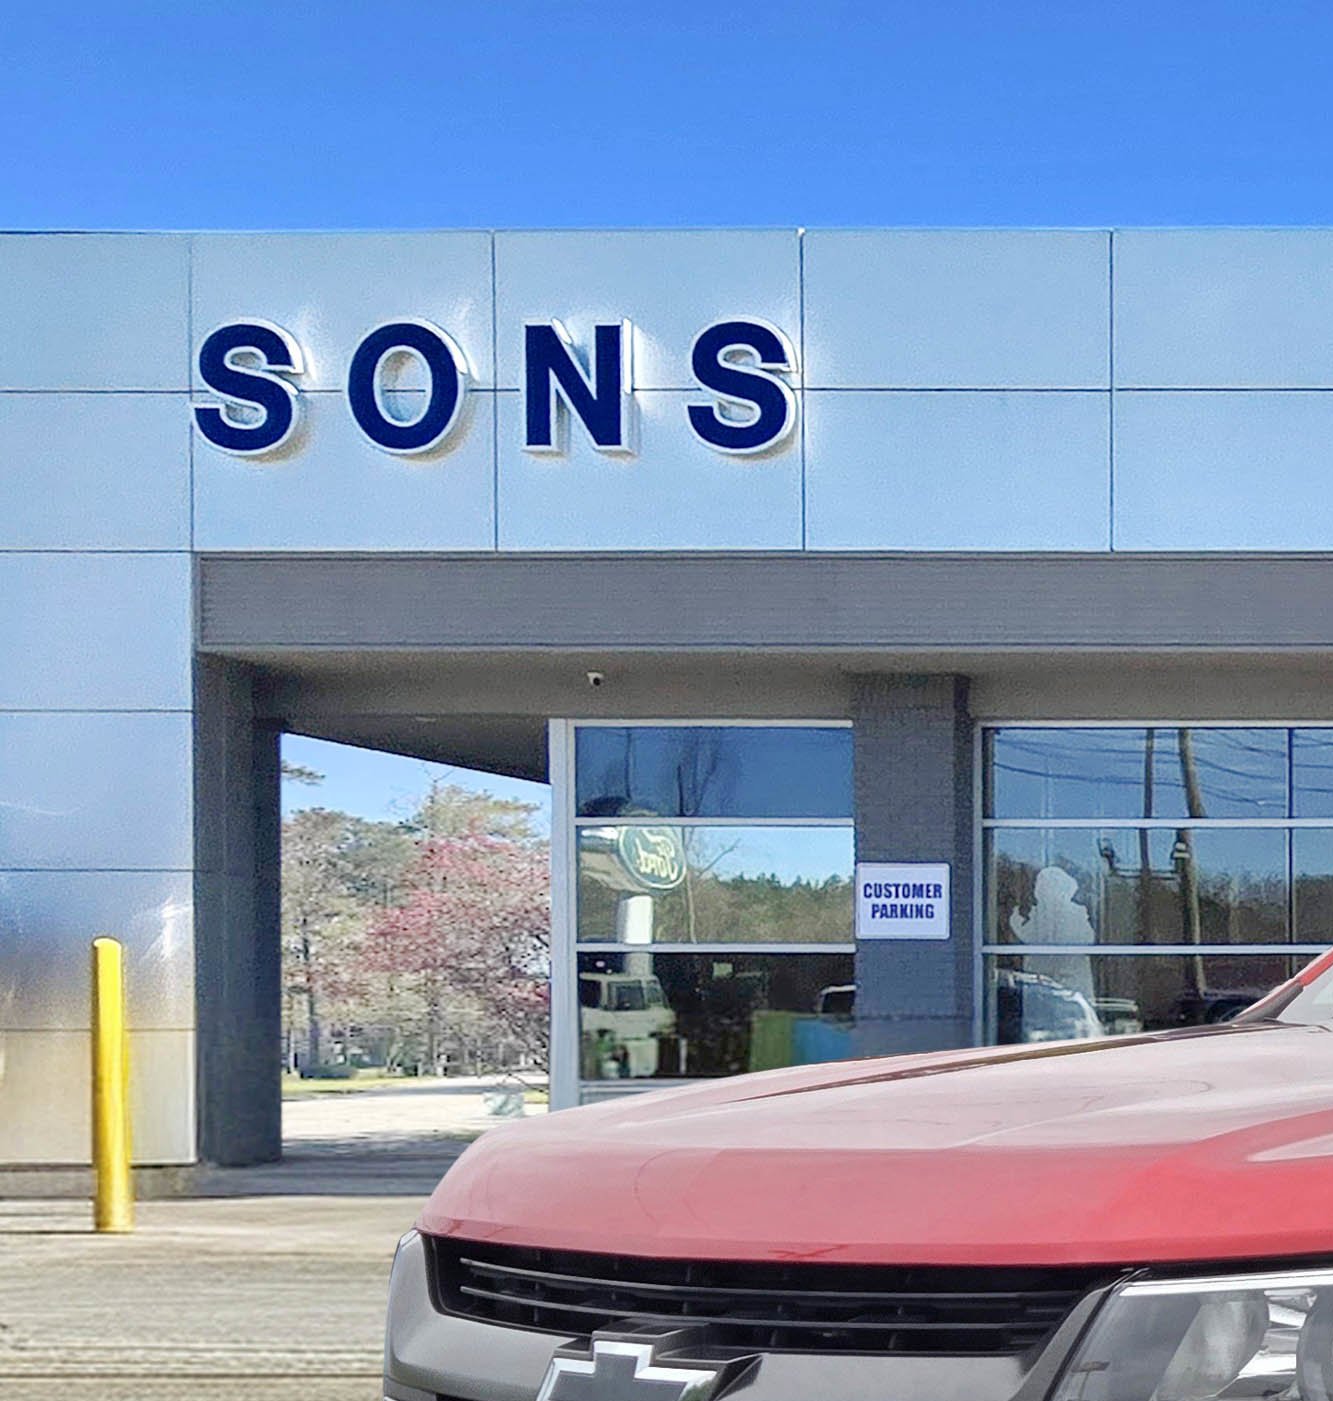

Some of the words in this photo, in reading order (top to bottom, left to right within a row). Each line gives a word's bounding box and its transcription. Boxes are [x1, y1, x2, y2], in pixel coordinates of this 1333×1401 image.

[193, 319, 798, 455] SONS
[863, 882, 942, 899] CUSTOMER
[871, 903, 935, 919] PARKING
